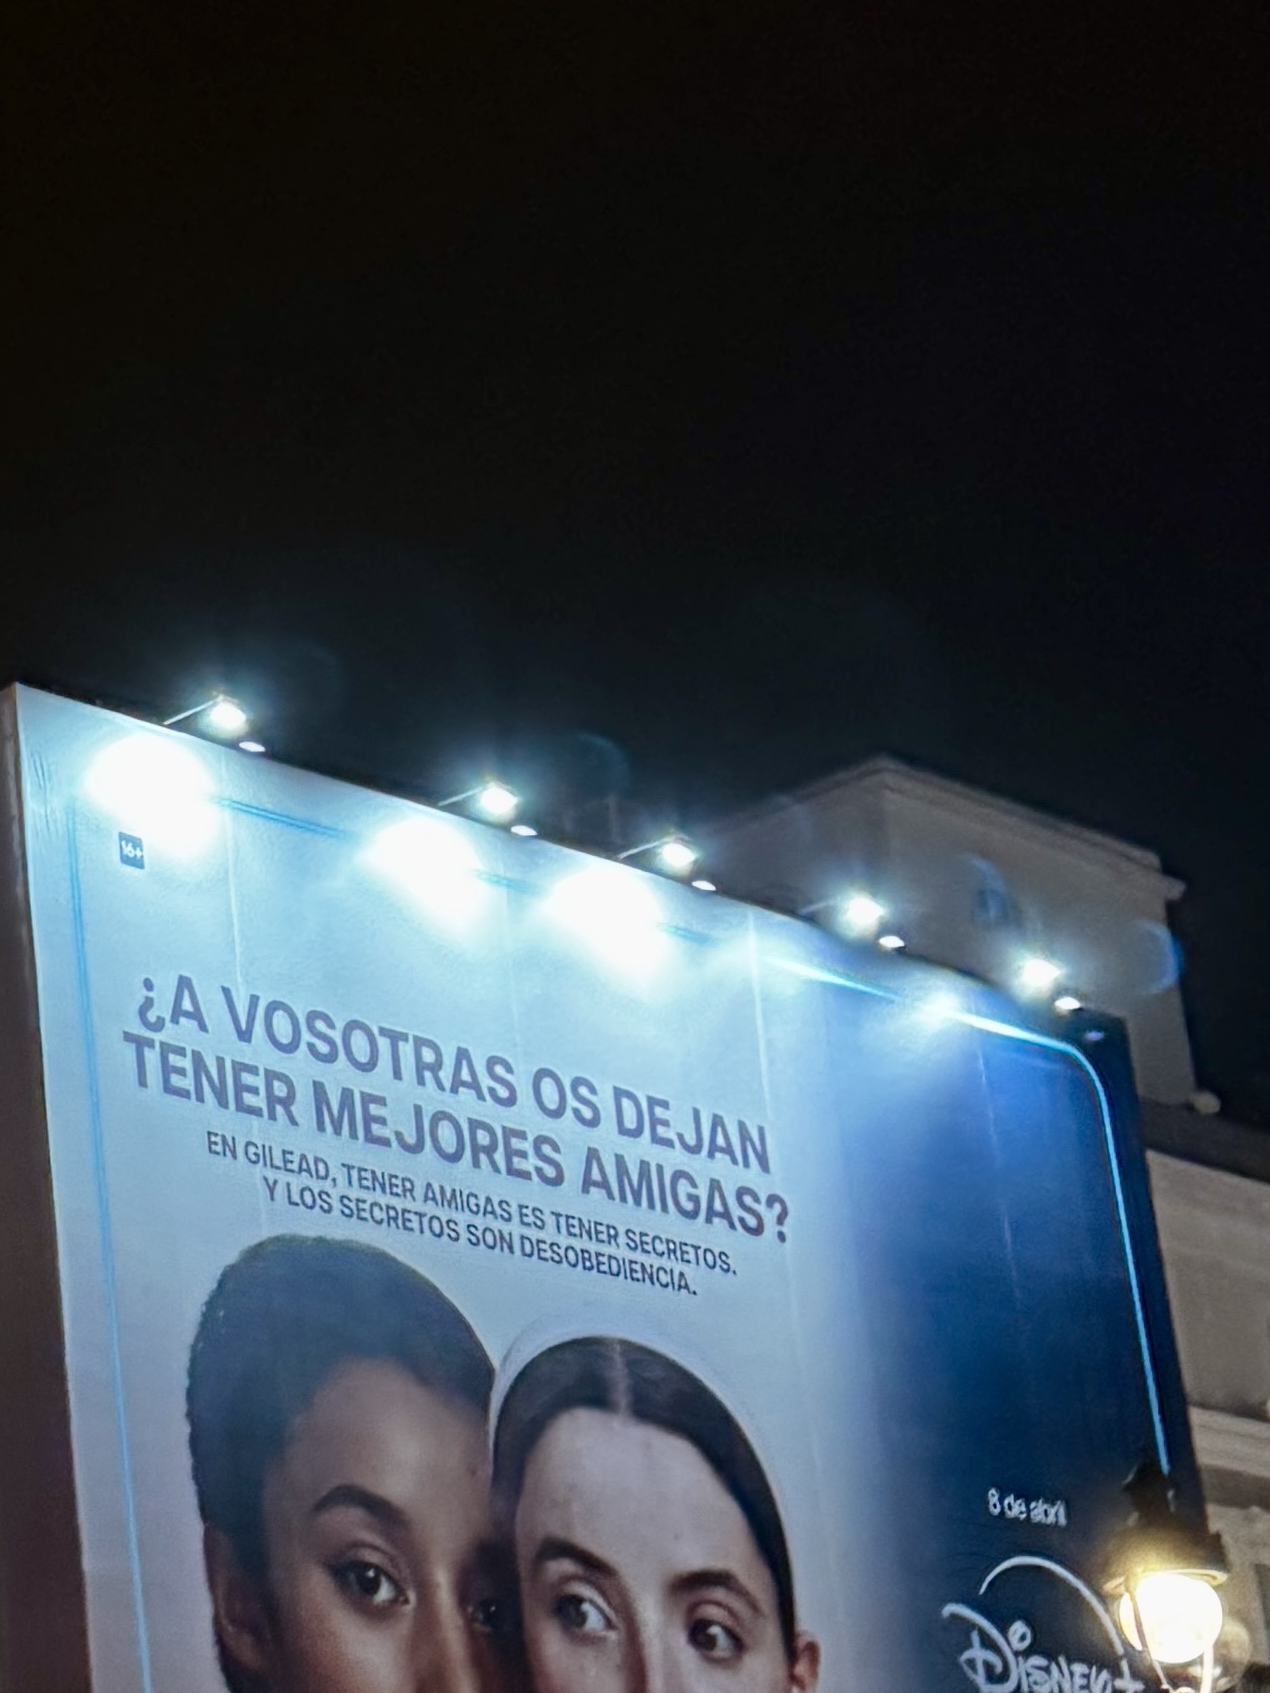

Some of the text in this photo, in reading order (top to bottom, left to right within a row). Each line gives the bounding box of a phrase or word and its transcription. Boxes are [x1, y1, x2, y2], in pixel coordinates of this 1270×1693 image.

[121, 840, 144, 859] 16+
[122, 1031, 790, 1244] TENER MEJORES AMIGAS?
[138, 974, 771, 1175] ¿A VOSOTRAS OS DEJAN
[206, 1130, 738, 1276] EN GILEAD, TENER AMIGAS ES TENER SECRETOS.
[264, 1175, 698, 1297] Y LOS SECRETOS SON DESOBEDIENCIA.
[988, 1488, 1001, 1516] 8
